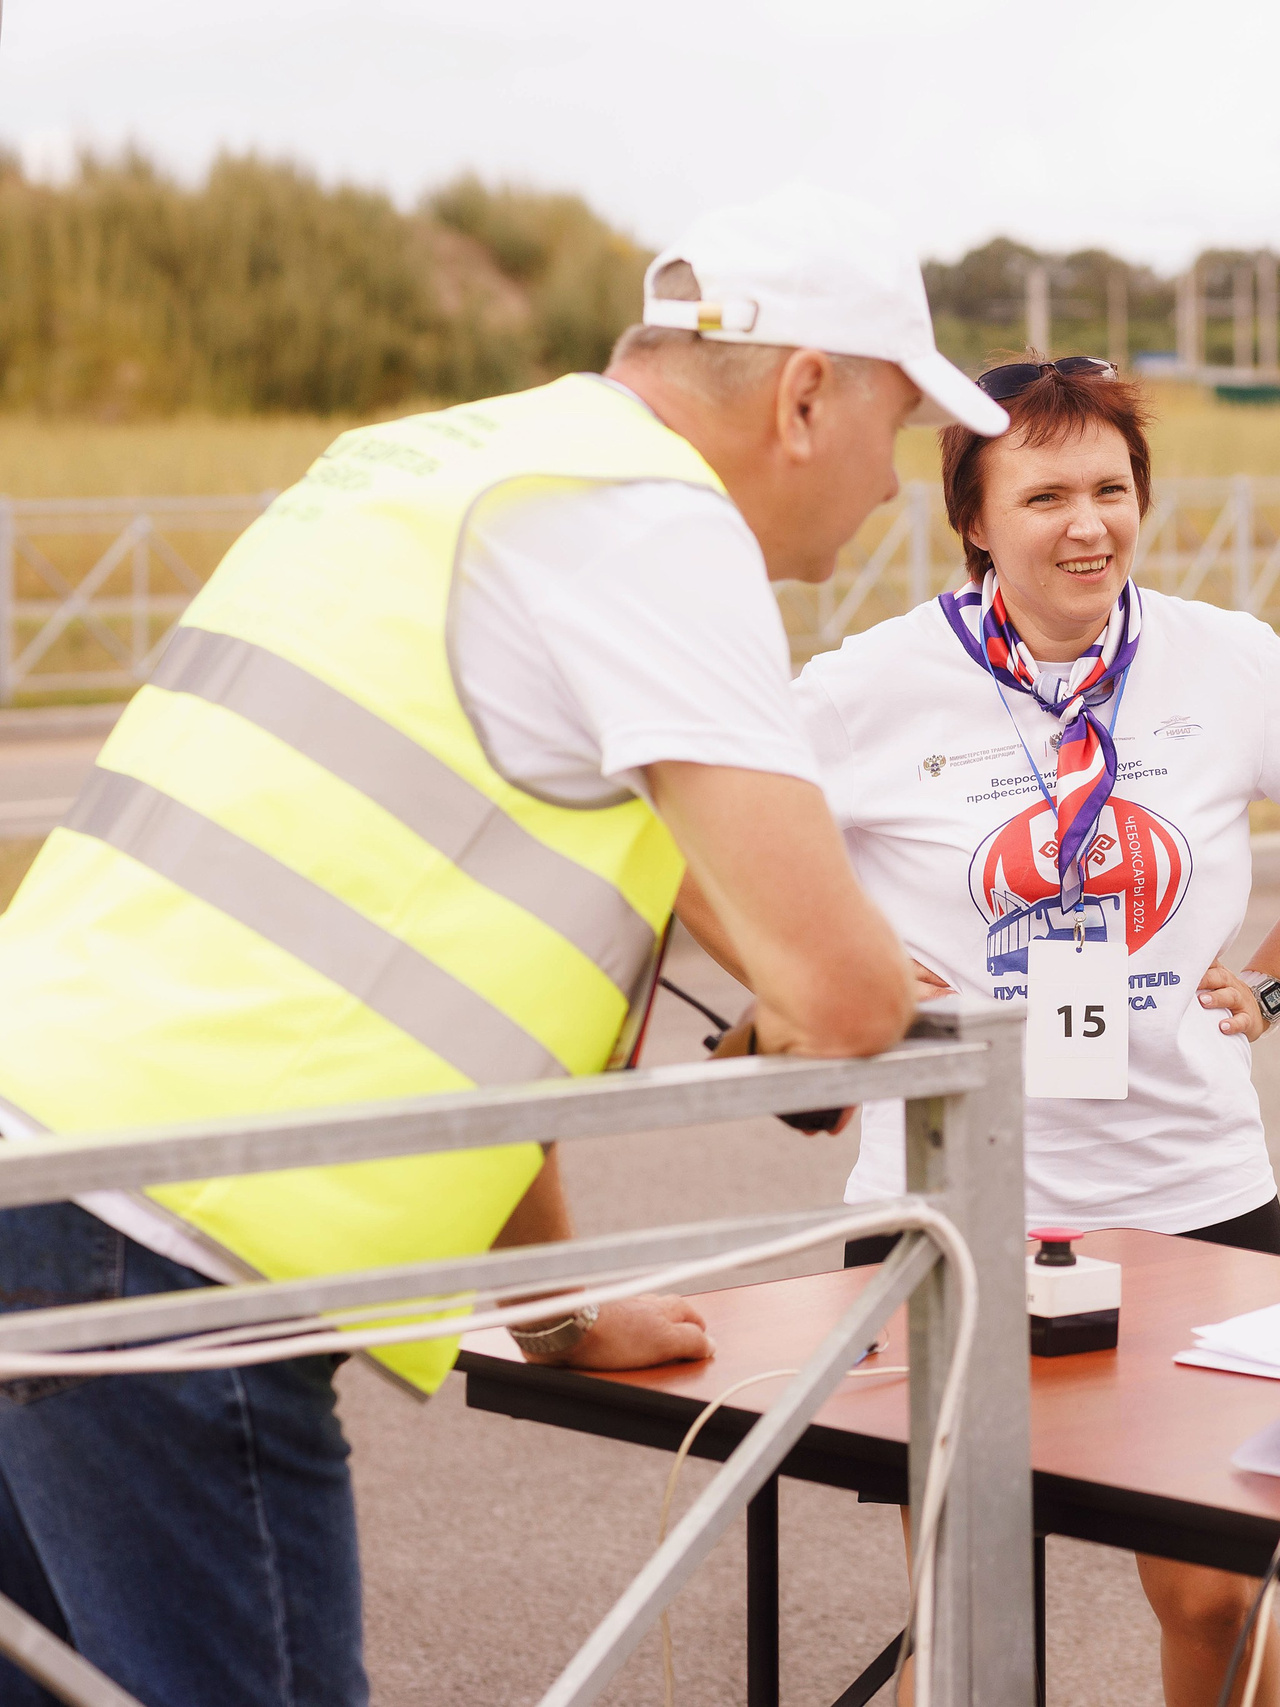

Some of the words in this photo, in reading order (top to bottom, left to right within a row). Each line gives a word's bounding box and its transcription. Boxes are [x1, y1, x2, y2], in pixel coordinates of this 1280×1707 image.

[949, 750, 990, 761] МИНИСТЕРСТВО
[991, 743, 1023, 754] ТРАНСПОРТА
[949, 756, 984, 767] РОССИЙСКОЙ
[984, 750, 1015, 761] ФЕДЕРАЦИИ
[1115, 766, 1168, 781] стерства
[1117, 760, 1142, 771] курс
[1125, 815, 1145, 897] ЧЕБОКСАРЫ
[1133, 899, 1145, 933] 2024
[993, 984, 1028, 1001] ЛУЧ
[1128, 971, 1181, 989] ИТЕЛЬ
[1056, 1005, 1106, 1038] 15
